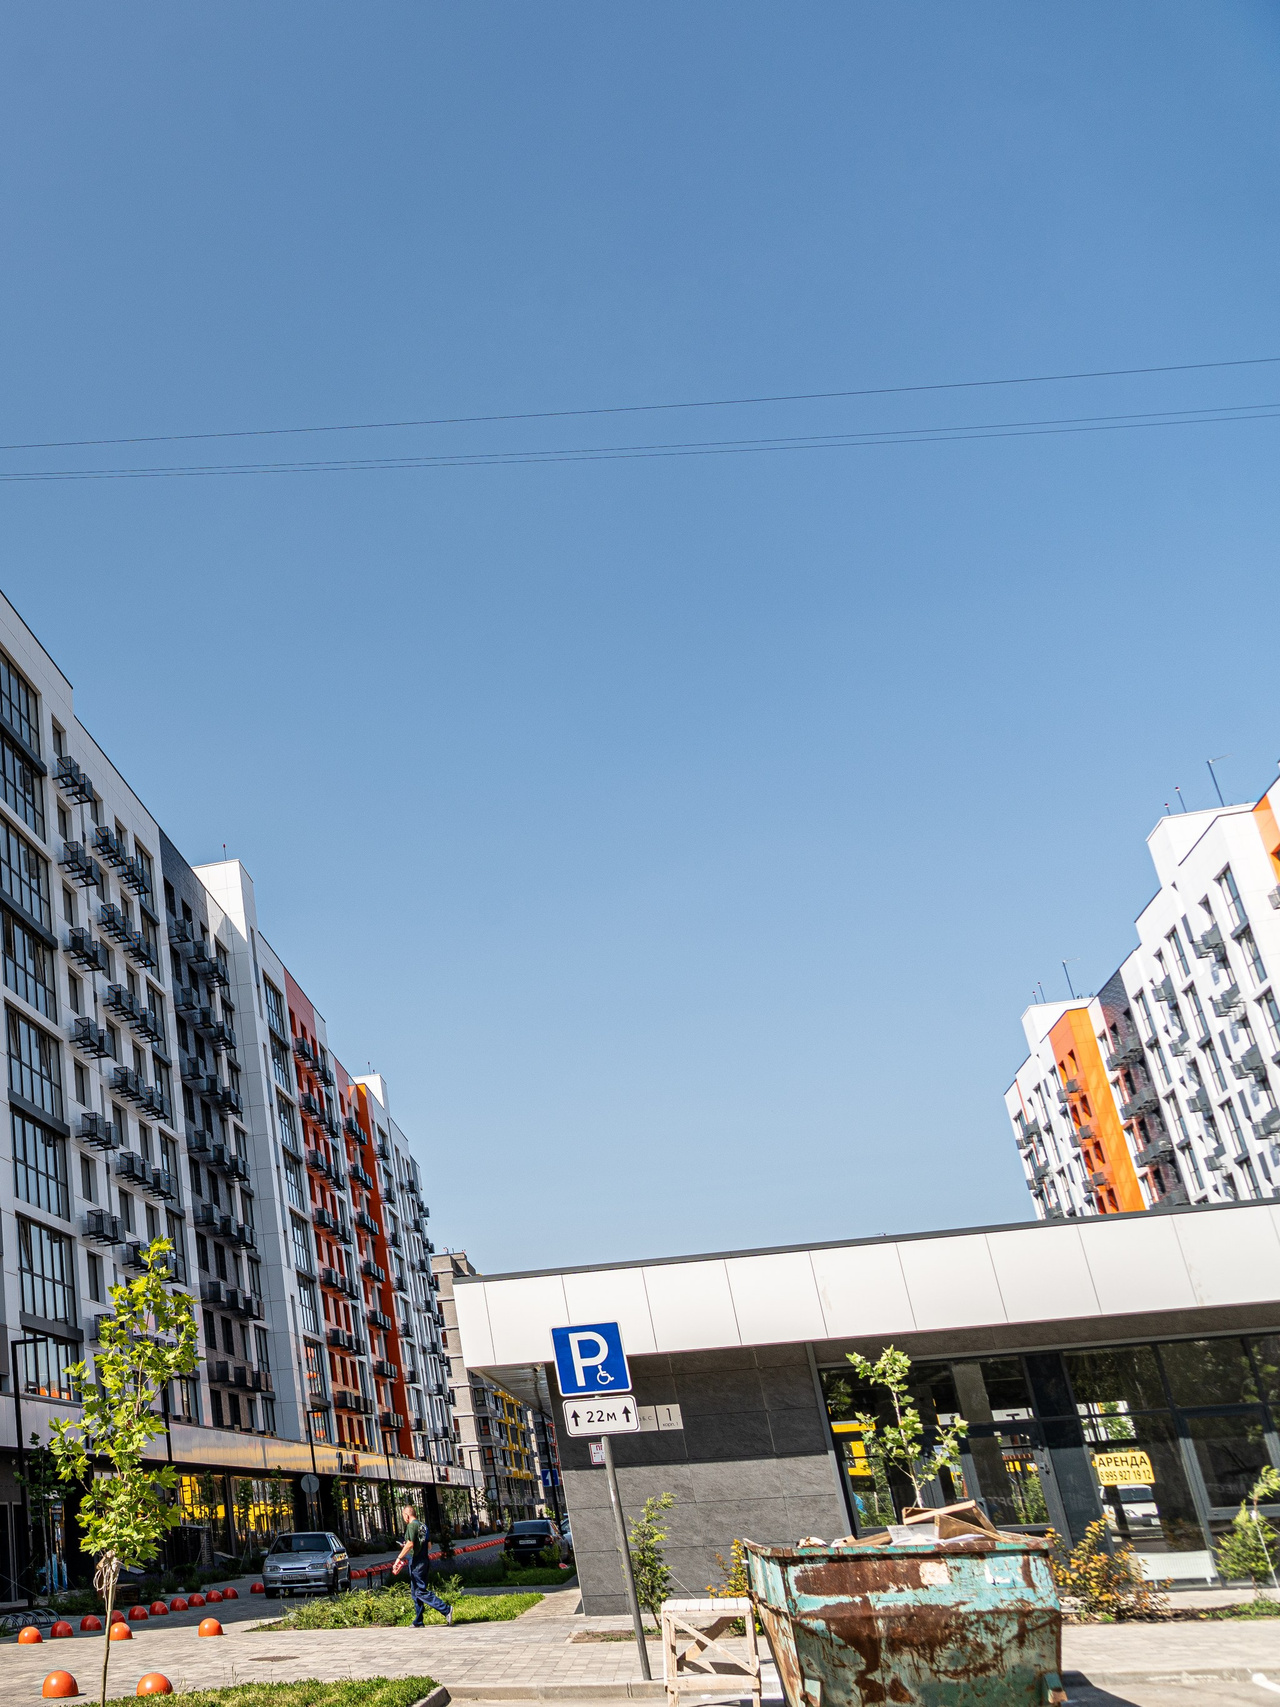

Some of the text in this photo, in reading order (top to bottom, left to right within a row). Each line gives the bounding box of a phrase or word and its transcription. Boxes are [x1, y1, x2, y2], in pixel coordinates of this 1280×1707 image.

[568, 1331, 609, 1387] P
[666, 1407, 672, 1421] 1
[1098, 1455, 1148, 1468] АРЕНДА
[1119, 1470, 1131, 1481] 927
[1133, 1470, 1141, 1480] 19
[1142, 1469, 1151, 1480] 12
